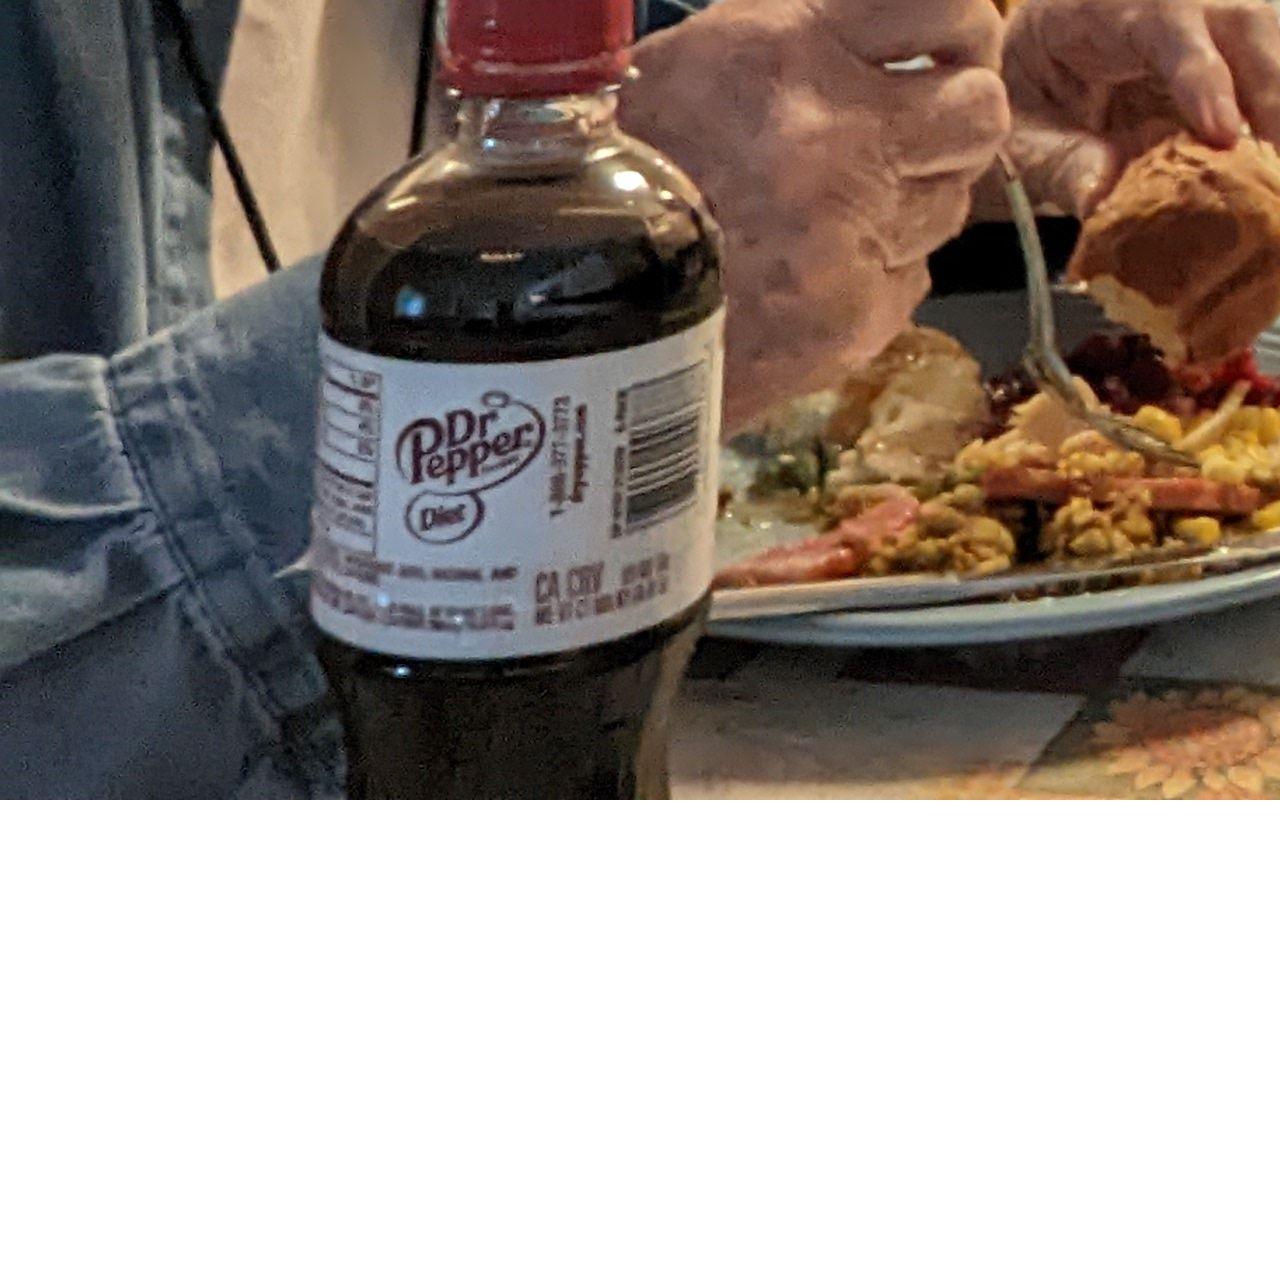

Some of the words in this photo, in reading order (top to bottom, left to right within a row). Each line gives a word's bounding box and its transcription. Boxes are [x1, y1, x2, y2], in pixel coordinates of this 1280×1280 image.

[447, 408, 500, 446] Dr
[410, 416, 534, 485] Pepper
[420, 504, 467, 532] Diet
